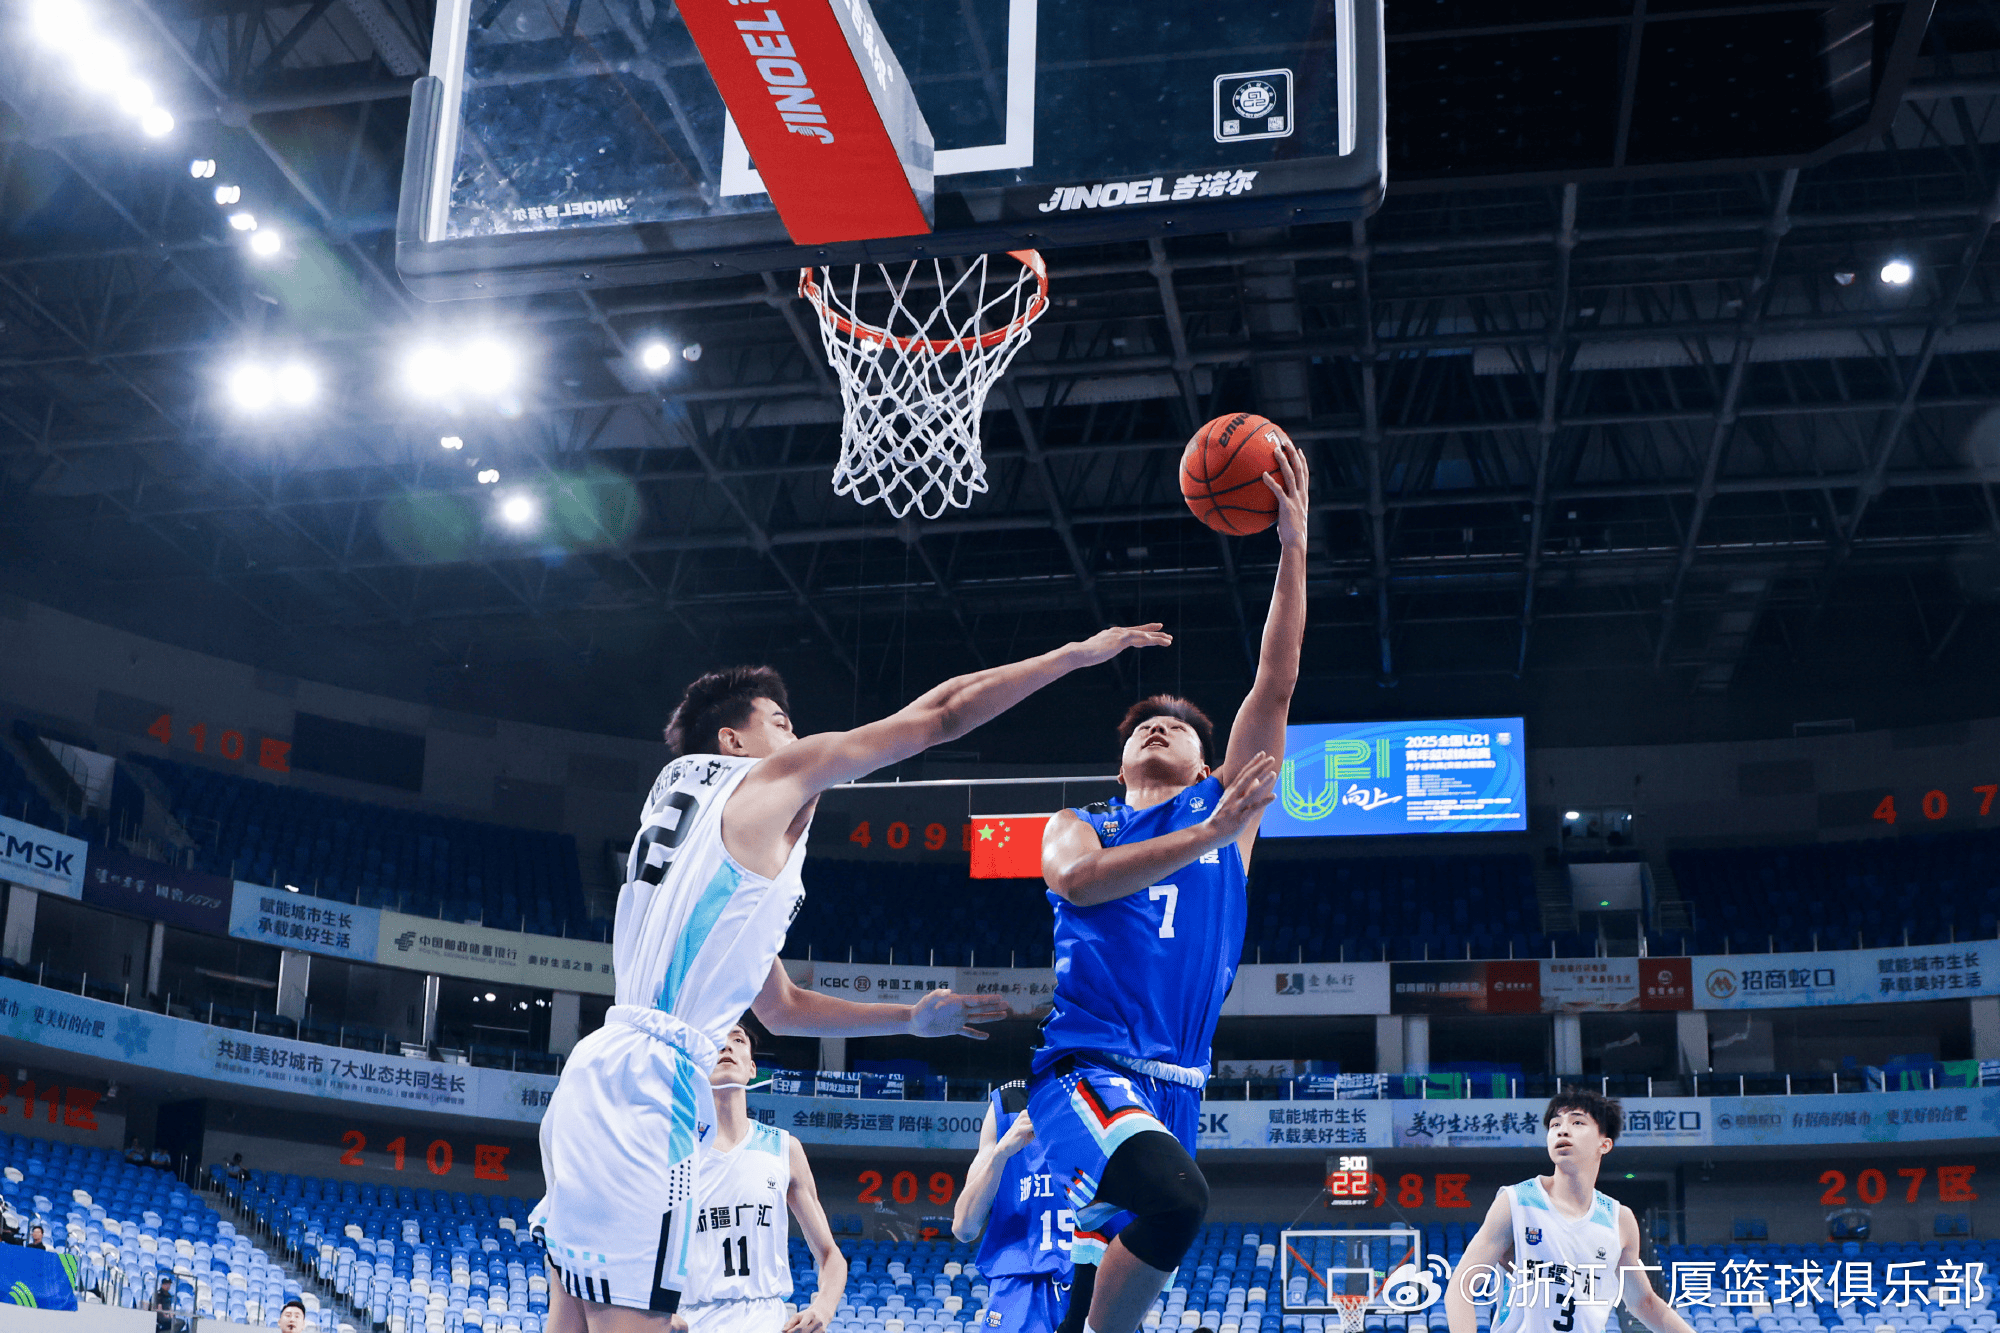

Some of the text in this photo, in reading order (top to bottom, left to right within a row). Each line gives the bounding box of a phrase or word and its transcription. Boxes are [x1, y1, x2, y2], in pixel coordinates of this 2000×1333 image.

[734, 10, 835, 145] JINOEL
[1342, 784, 1403, 811] 向上
[259, 897, 352, 929] 赋能城市生长
[1148, 884, 1179, 939] 7
[258, 916, 350, 949] 承载美好生活
[419, 935, 518, 960] 中国邮政储蓄银行
[1877, 952, 1980, 974] 赋能城市生长
[820, 976, 849, 989] ICBC
[877, 979, 949, 992] 中国工商银行
[1741, 968, 1836, 991] 招商蛇口
[1879, 972, 1982, 993] 承载美好生活
[218, 1038, 323, 1074] 共建美好城市
[791, 1107, 895, 1132] 全维服务运营
[900, 1113, 936, 1132] 陪伴
[1268, 1107, 1367, 1124] 赋能城市生长
[1405, 1110, 1540, 1138] 美好生活承载者
[1268, 1127, 1367, 1144] 承载美好生活
[1019, 1173, 1054, 1202] 浙江
[1332, 1171, 1369, 1196] 22
[1039, 1209, 1076, 1252] 15
[722, 1235, 751, 1278] 11
[1552, 1292, 1577, 1333] 3
